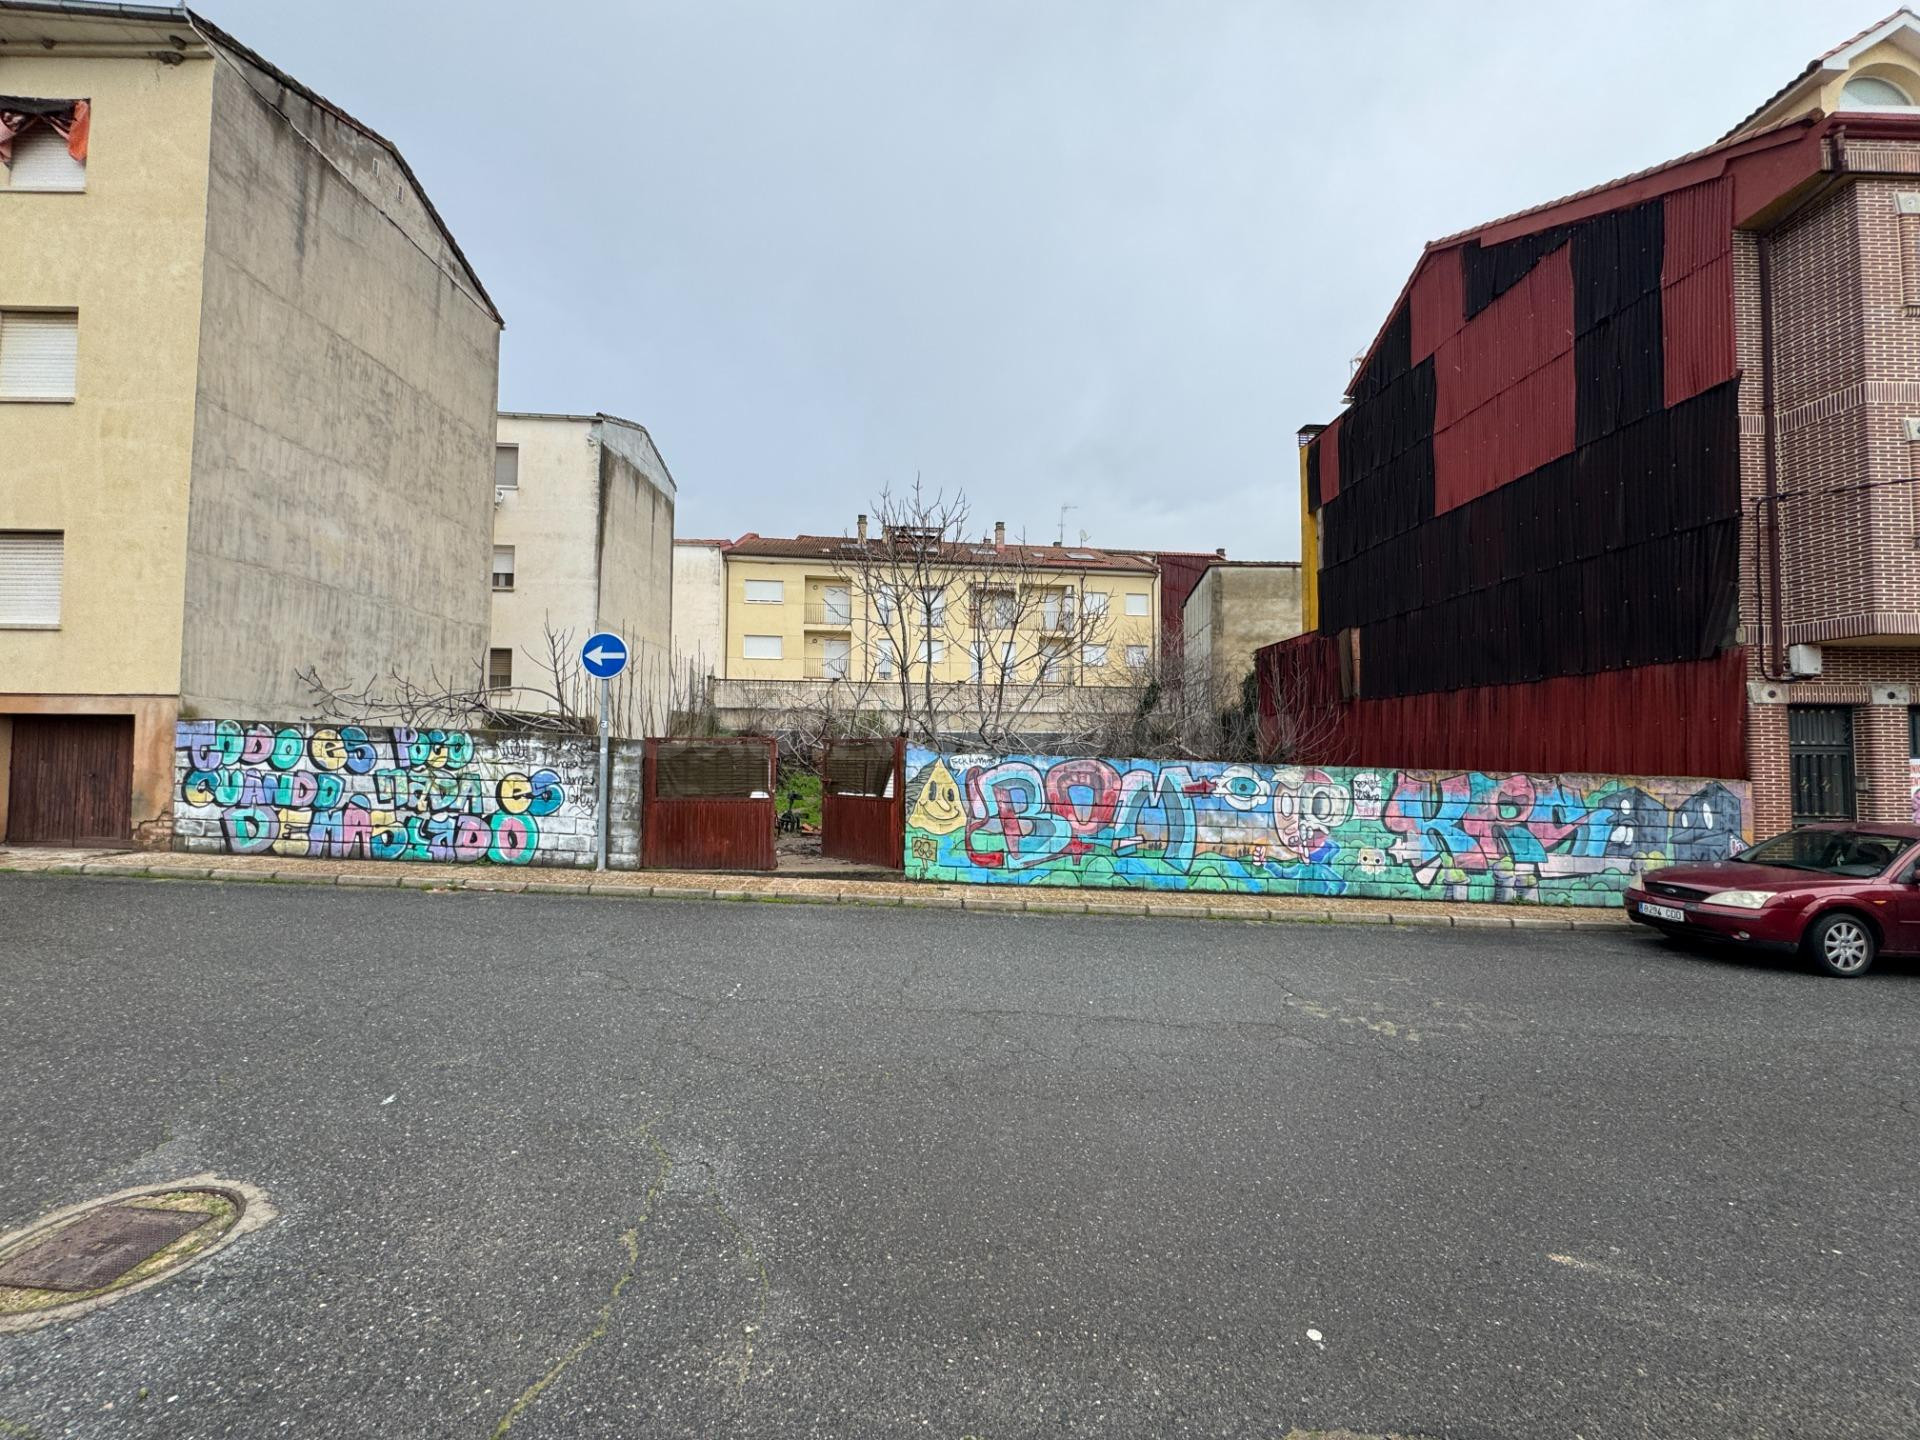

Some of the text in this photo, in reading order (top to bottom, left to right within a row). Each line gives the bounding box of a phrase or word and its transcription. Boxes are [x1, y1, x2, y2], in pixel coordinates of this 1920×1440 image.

[175, 719, 304, 772] TODO
[390, 727, 475, 769] POCO
[182, 768, 347, 809] CUANDO
[219, 796, 540, 866] DEMASIADO
[1643, 904, 1662, 915] 8294
